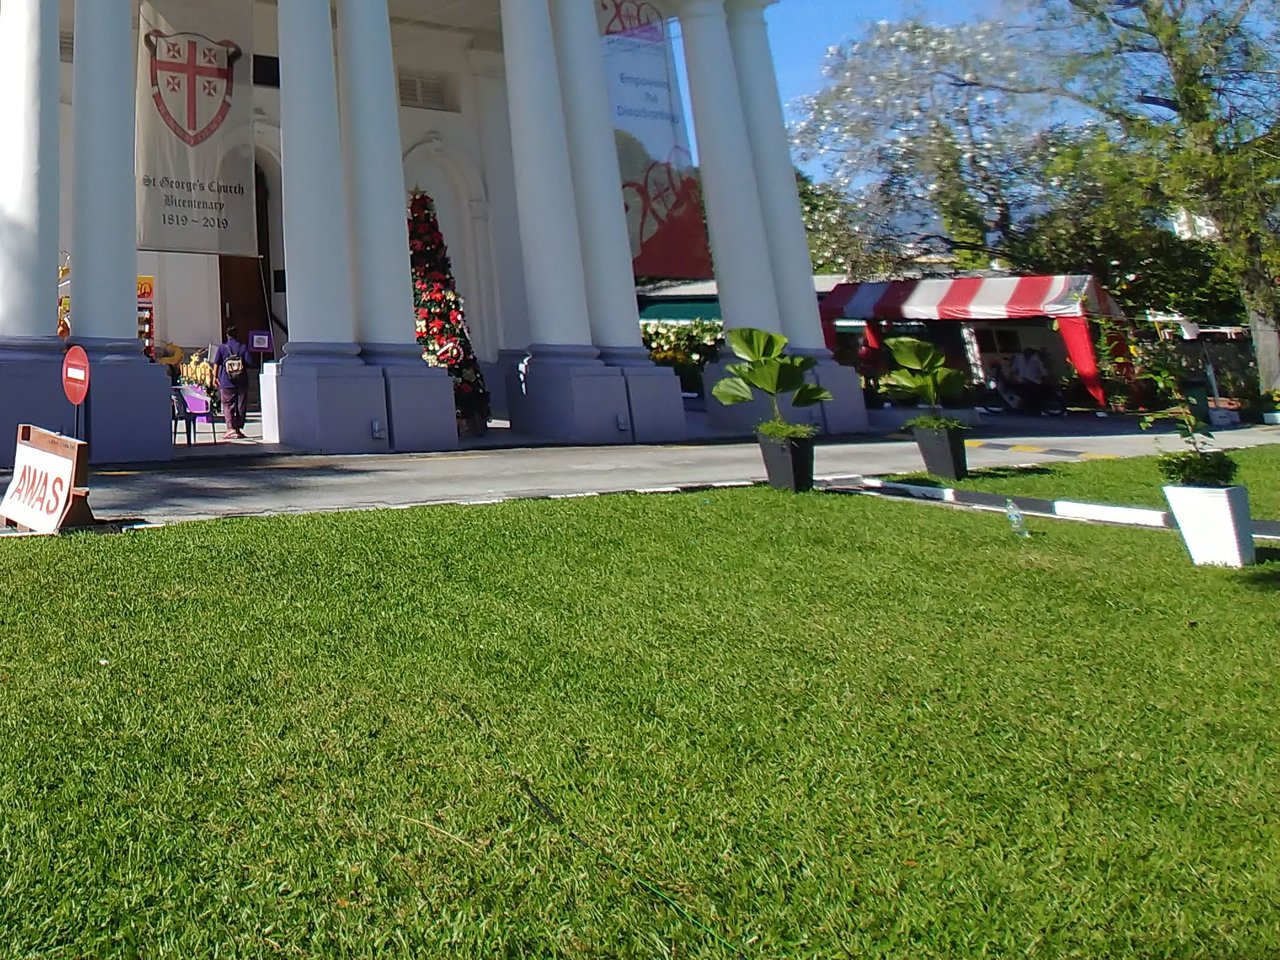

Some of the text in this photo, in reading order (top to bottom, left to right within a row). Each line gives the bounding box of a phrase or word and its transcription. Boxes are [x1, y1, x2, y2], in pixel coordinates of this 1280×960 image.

[142, 174, 244, 195] St George's Church
[161, 213, 188, 226] 1819
[202, 216, 228, 229] 2019
[9, 464, 64, 516] AWAS
